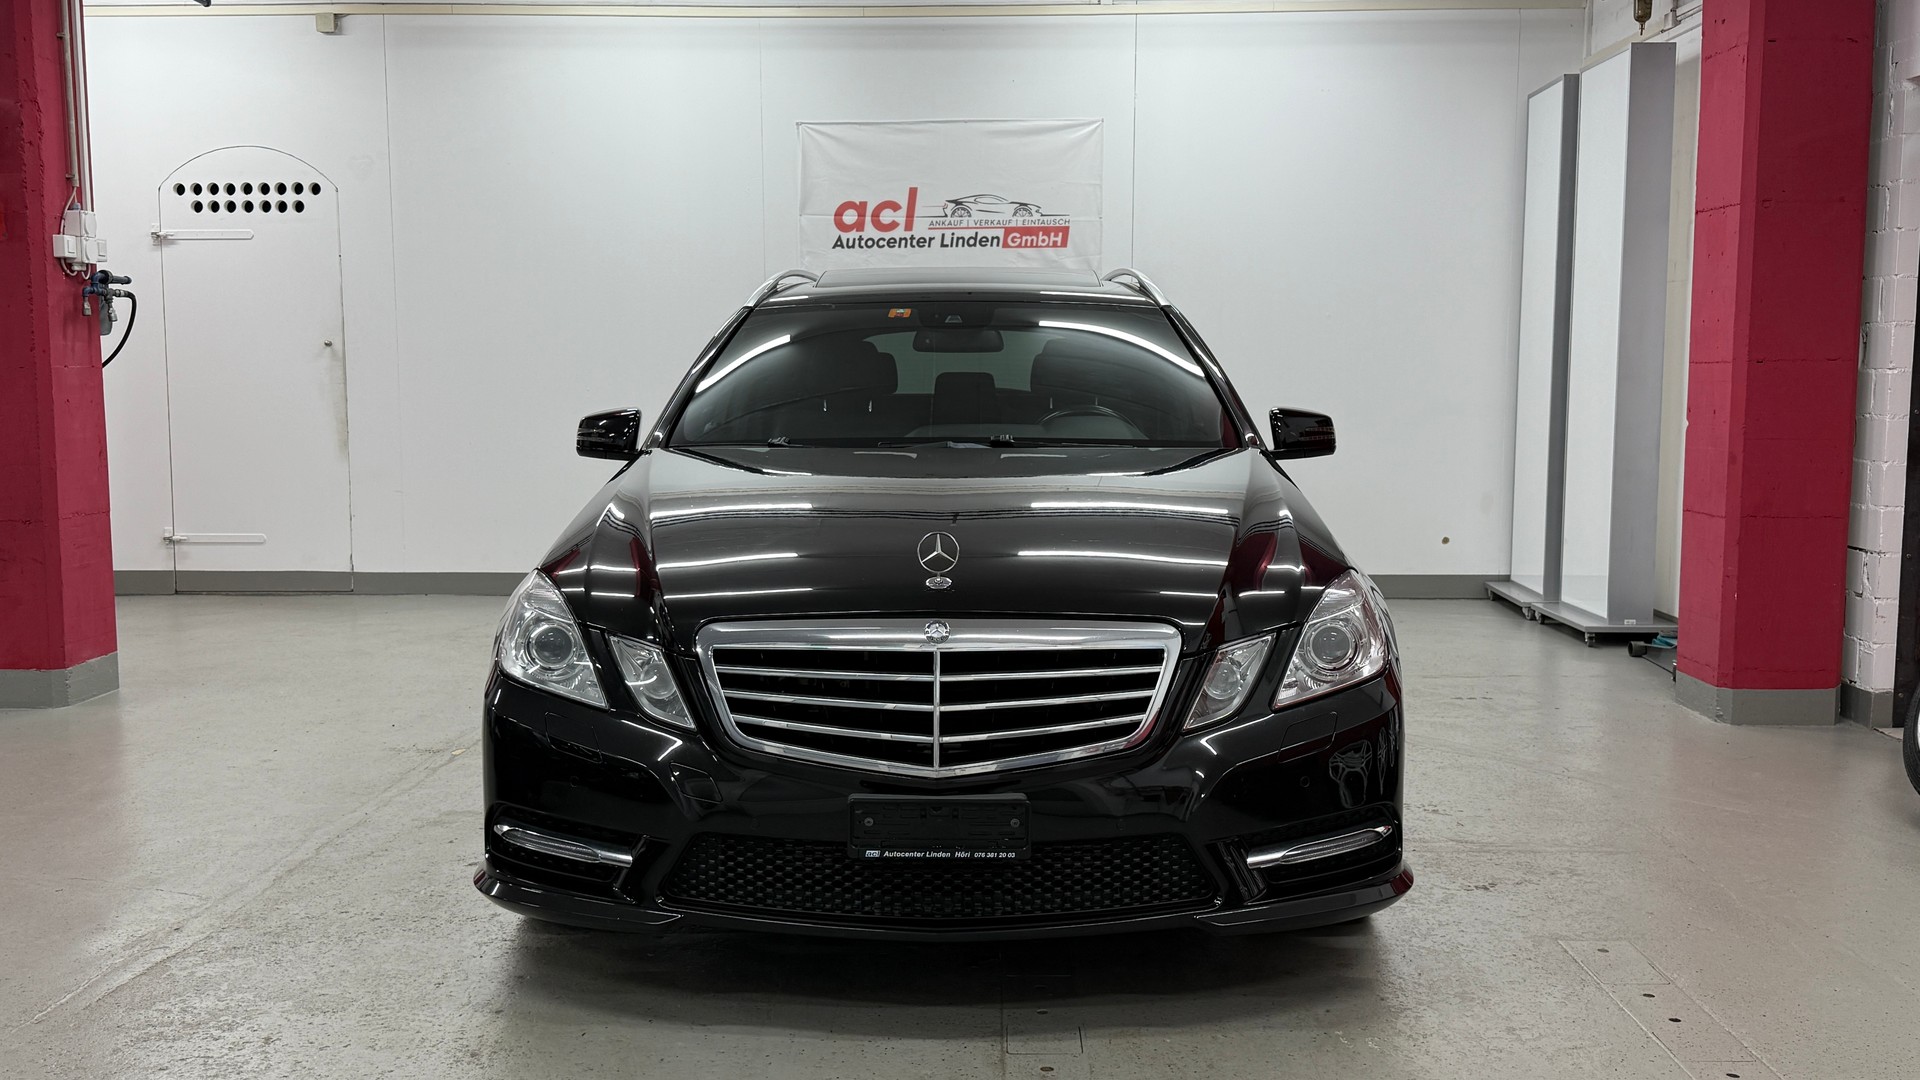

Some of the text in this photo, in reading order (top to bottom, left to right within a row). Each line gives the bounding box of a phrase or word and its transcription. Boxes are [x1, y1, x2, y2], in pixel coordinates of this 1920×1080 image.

[833, 186, 918, 233] acl
[928, 218, 1071, 227] ANKAUF VERKAUF EINTAUSCH
[831, 231, 1063, 249] Autocenter Linden GmbH
[883, 850, 925, 858] Autocenter
[926, 850, 951, 858] Linden
